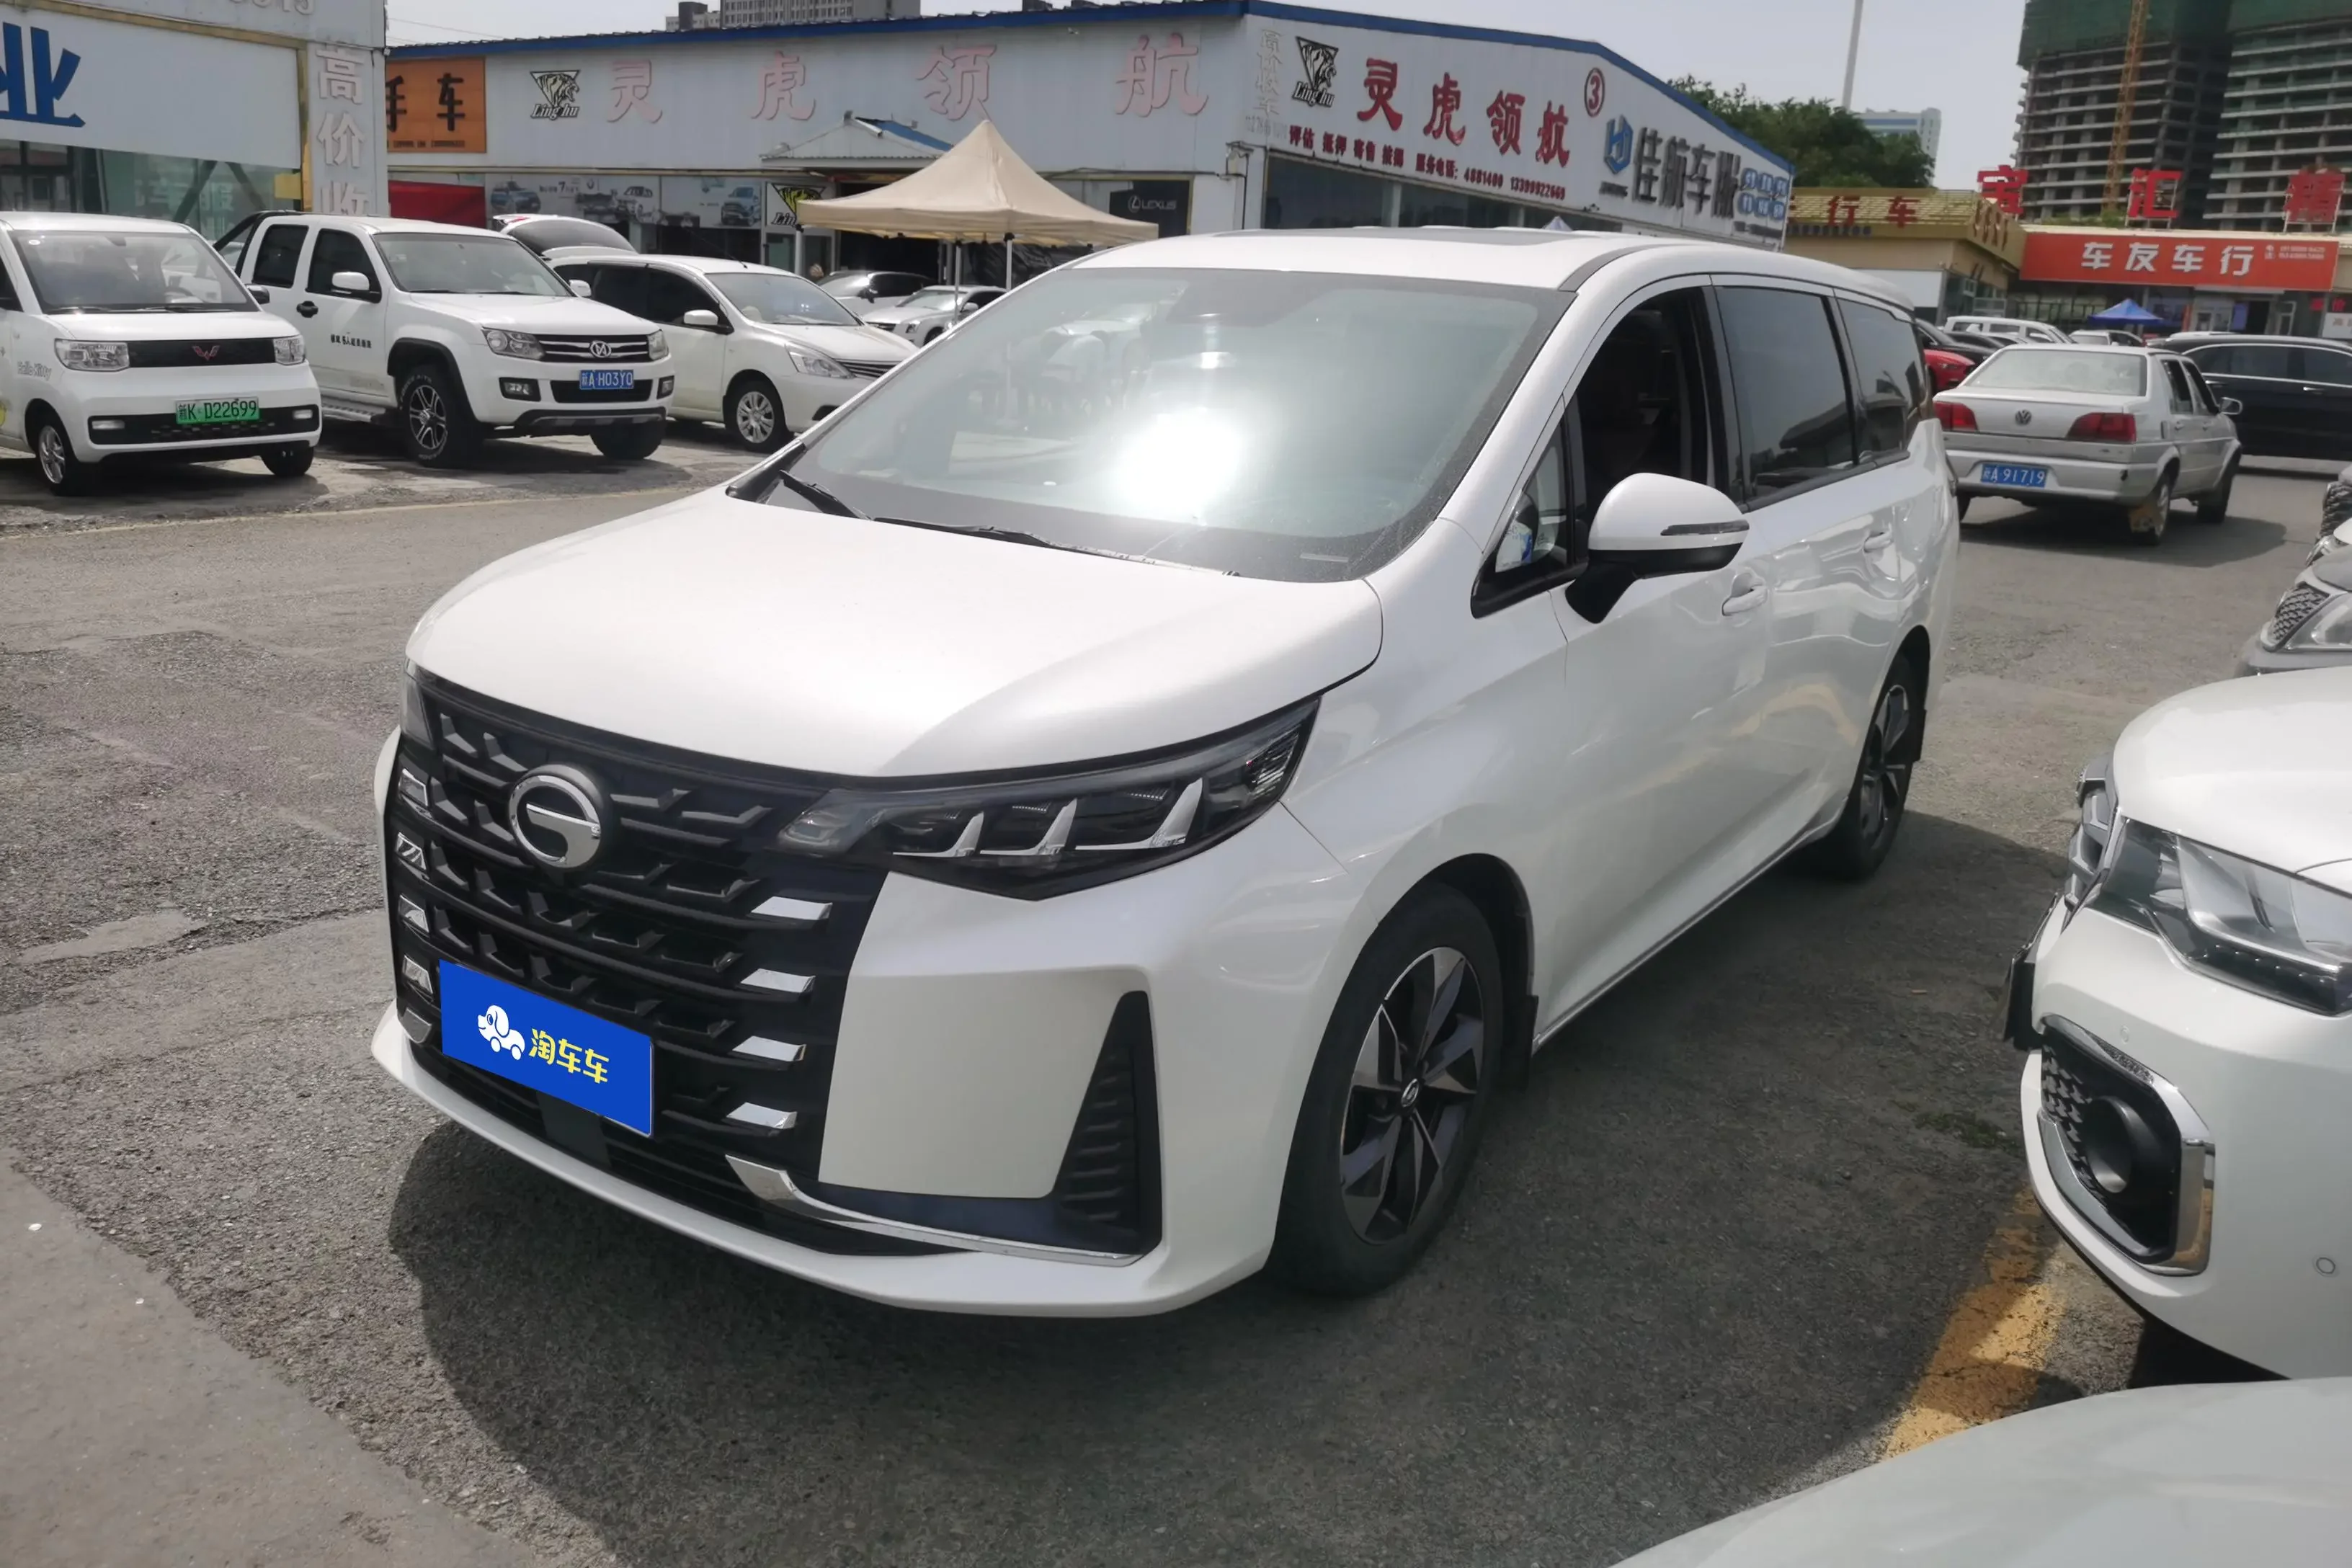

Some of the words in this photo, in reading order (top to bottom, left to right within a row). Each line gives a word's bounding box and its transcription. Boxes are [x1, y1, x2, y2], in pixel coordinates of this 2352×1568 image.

[530, 103, 560, 120] Ling
[561, 103, 579, 117] hu
[1357, 57, 1570, 168] 灵虎领航
[2080, 241, 2255, 275] 车友车行
